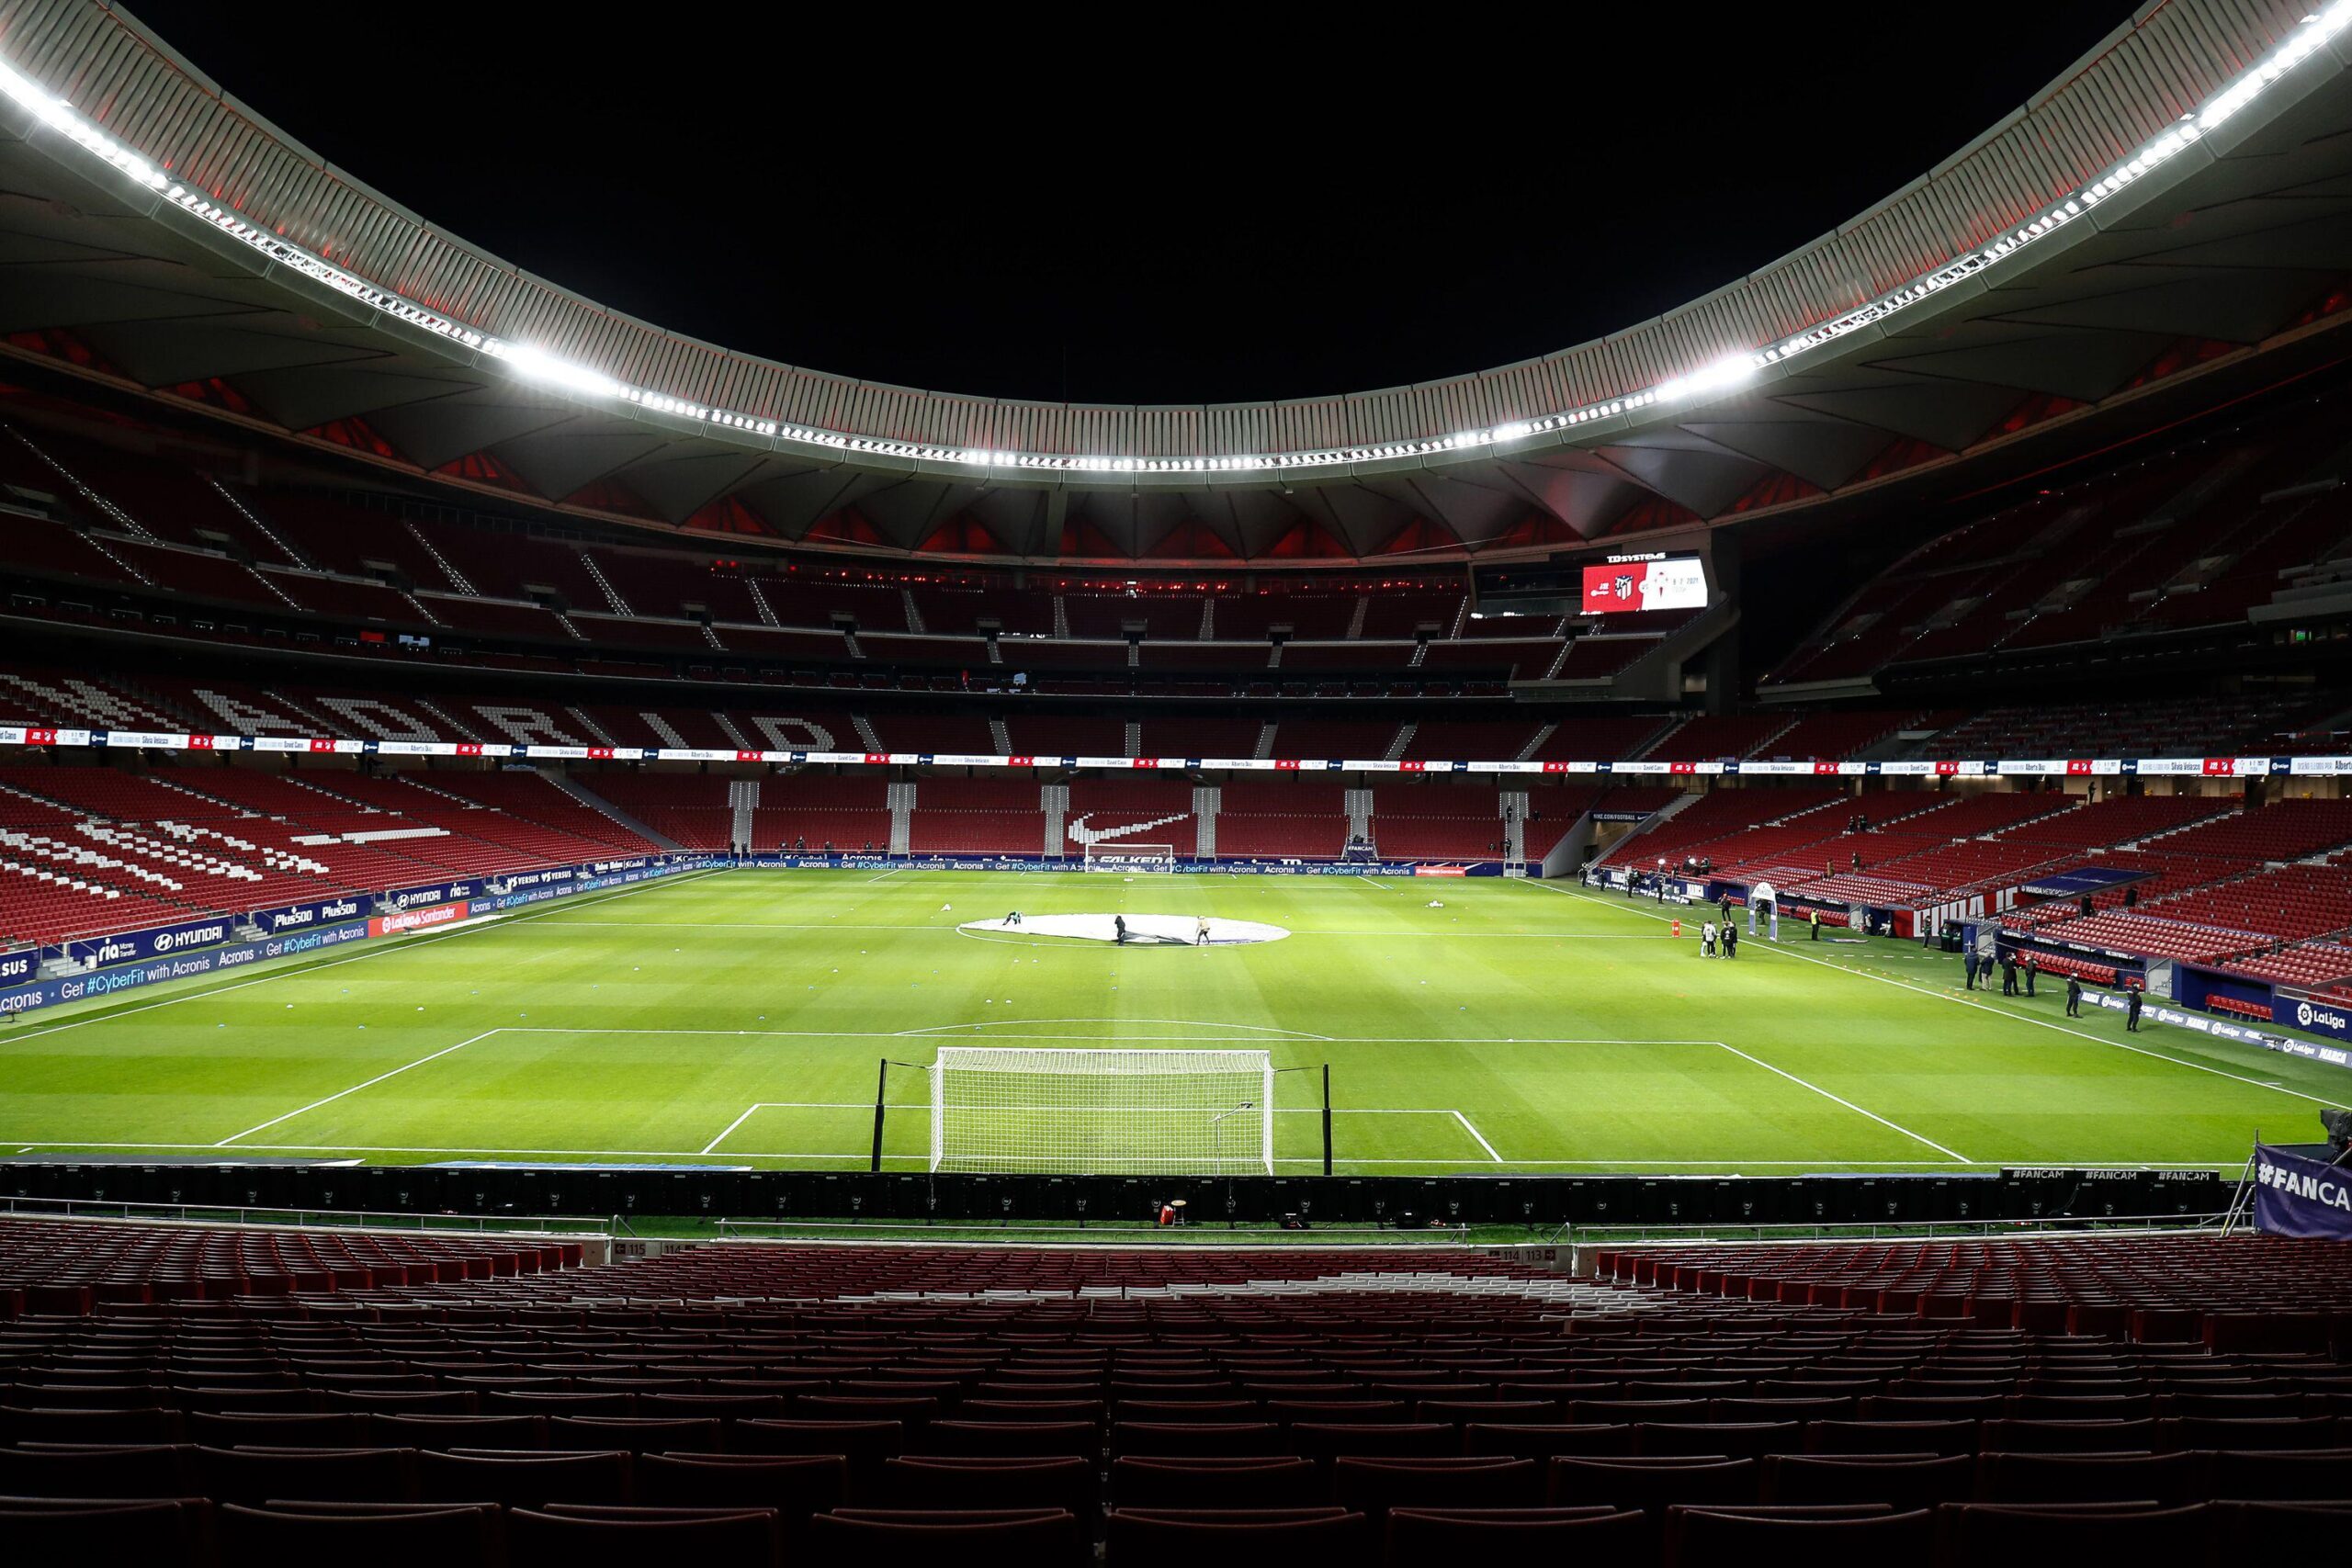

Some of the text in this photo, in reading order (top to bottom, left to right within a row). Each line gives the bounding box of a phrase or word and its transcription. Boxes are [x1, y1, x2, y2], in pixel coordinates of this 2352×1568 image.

[1621, 552, 1666, 562] SYSTEMS
[857, 862, 896, 870] #CyberFit
[953, 862, 984, 870] Acronis
[1012, 863, 1050, 872] #CyberFit
[1264, 865, 1295, 874] Acronis
[1322, 866, 1361, 875] #CyberFit
[518, 874, 539, 885] VERSUS
[551, 870, 571, 880] VERSUS
[2026, 886, 2042, 894] WANDA
[410, 890, 441, 905] HYUNDAI
[496, 887, 554, 908] Get #CyberFit with Acronis
[322, 900, 356, 919] Plus500
[470, 901, 491, 914] Acronis
[275, 908, 313, 927] Plus500
[422, 907, 456, 924] Santander
[175, 926, 222, 947] HYUNDAI
[266, 926, 365, 956] Get #CyberFit with Acronis
[98, 937, 119, 963] ria
[219, 948, 254, 966] Acronis
[0, 959, 28, 976] SUS
[62, 955, 210, 999] Get #CyberFit with Acronis
[2313, 1010, 2346, 1030] LaLiga
[2293, 1043, 2315, 1055] LaLiga
[2318, 1048, 2347, 1064] MARCA
[2012, 1170, 2064, 1179] #FANCAM
[2086, 1171, 2137, 1180] #FANCAM
[2158, 1171, 2210, 1181] #FANCAM
[629, 1244, 646, 1255] 115
[666, 1246, 681, 1255] 114
[1504, 1250, 1520, 1260] 114
[1526, 1250, 1542, 1261] 113
